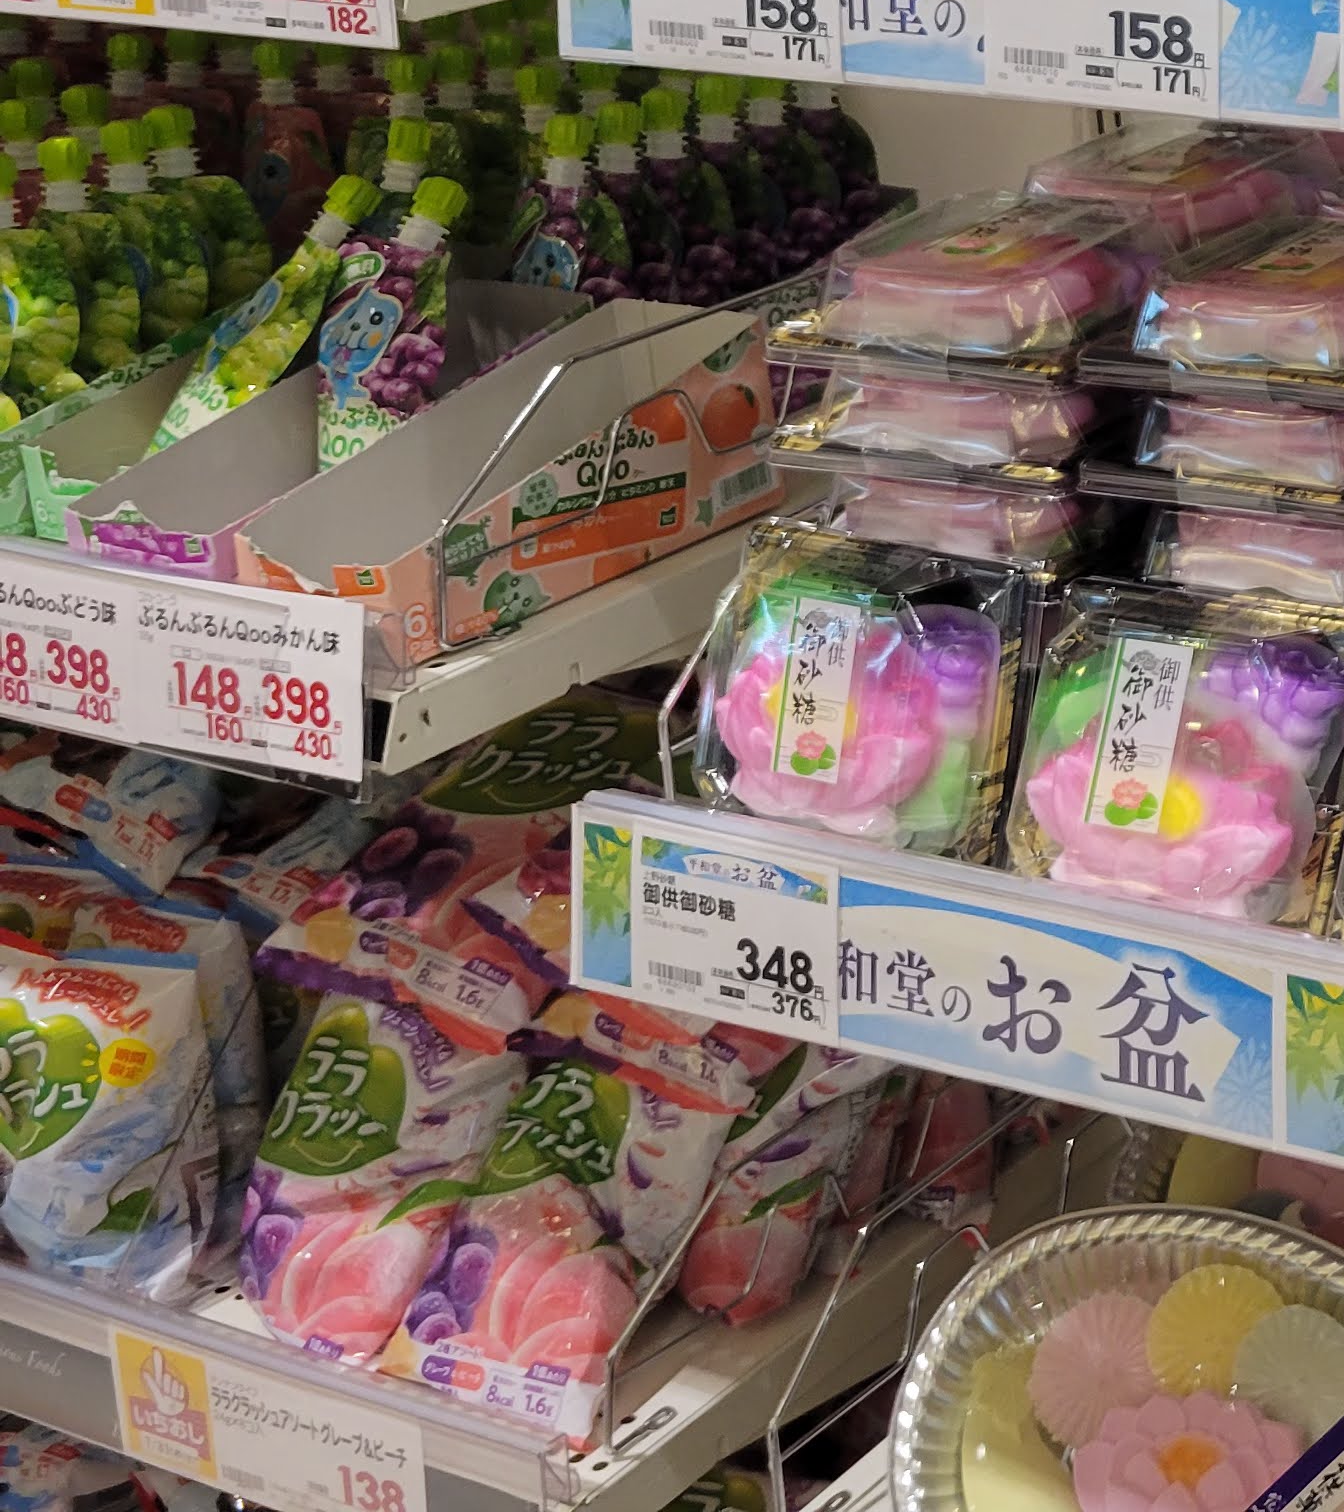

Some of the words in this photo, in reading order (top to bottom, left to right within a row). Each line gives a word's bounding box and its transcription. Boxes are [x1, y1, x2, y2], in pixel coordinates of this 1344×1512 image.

[1153, 657, 1182, 712] 御供
[529, 712, 618, 752] ララ
[1108, 666, 1155, 774] 御砂糖
[460, 744, 631, 788] クラッシュ
[643, 882, 736, 922] 御供御砂糖
[308, 1037, 369, 1096] ララ
[133, 1403, 205, 1445] いちおし
